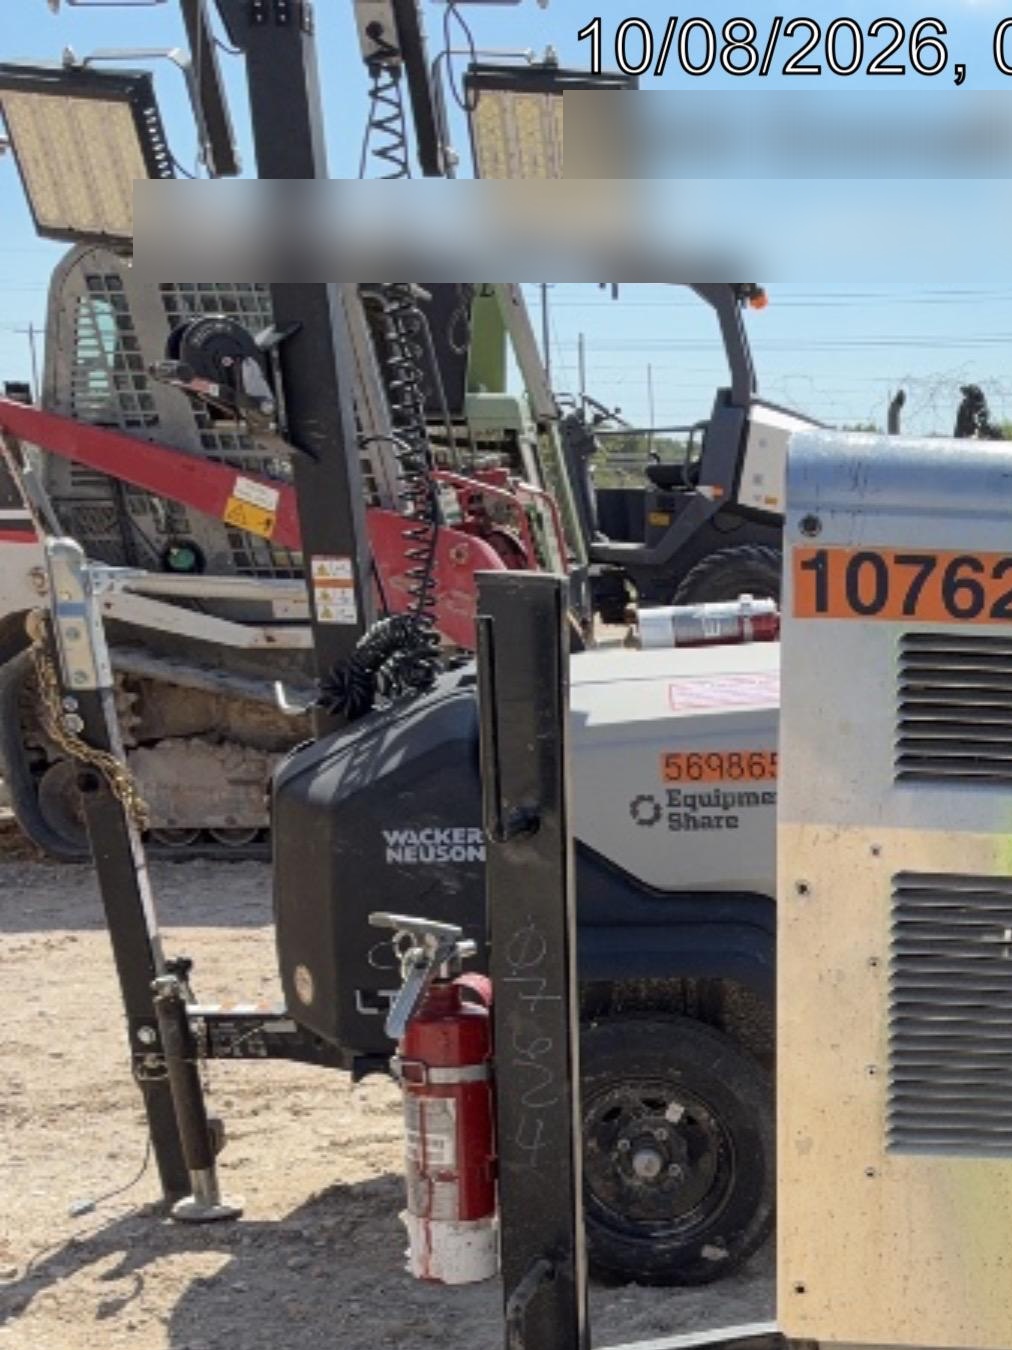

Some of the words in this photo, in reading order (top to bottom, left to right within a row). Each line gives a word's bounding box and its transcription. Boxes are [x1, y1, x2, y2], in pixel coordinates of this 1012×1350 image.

[668, 813, 739, 832] Share
[383, 827, 484, 845] WACKER
[386, 845, 487, 864] NEUSON
